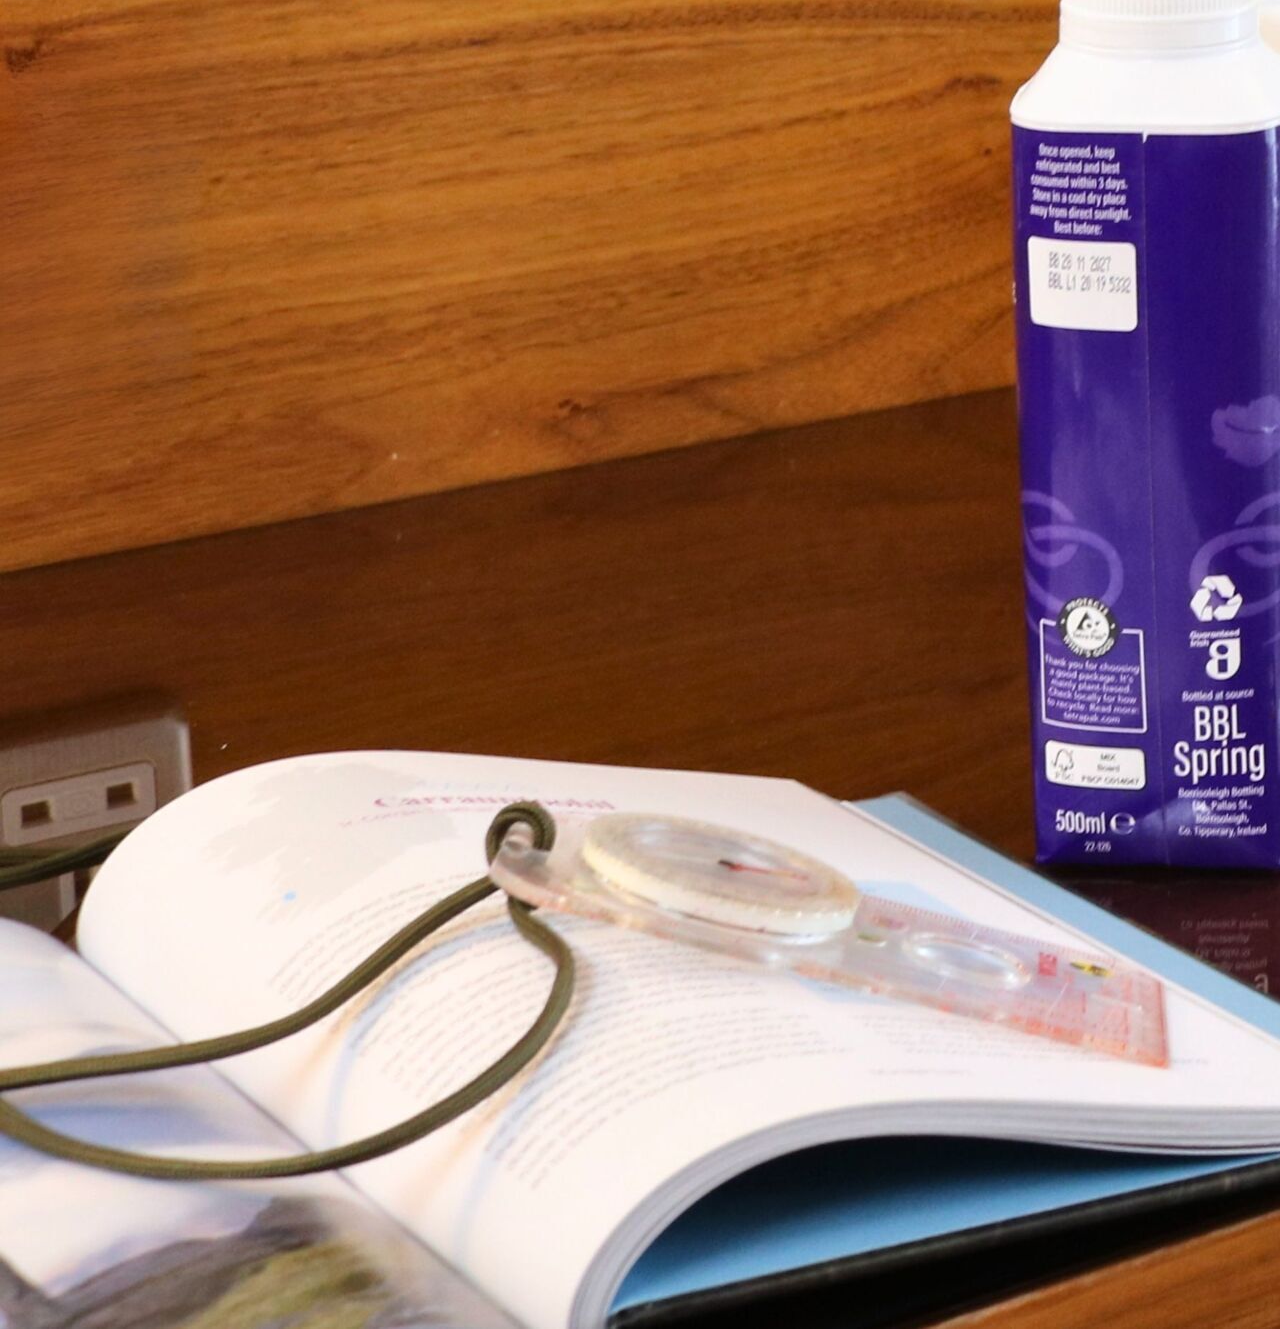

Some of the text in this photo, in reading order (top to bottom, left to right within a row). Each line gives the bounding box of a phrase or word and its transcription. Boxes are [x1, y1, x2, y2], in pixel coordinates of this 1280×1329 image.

[1039, 143, 1059, 158] Once
[1095, 145, 1115, 161] keep
[1036, 158, 1120, 175] refrigerated and best
[1031, 174, 1069, 188] consumed
[1070, 176, 1097, 189] within
[1098, 176, 1104, 190] 3
[1033, 187, 1051, 202] Store
[1052, 189, 1060, 203] in
[1068, 190, 1086, 205] cool
[1087, 191, 1102, 207] dry
[1103, 191, 1126, 207] place
[1030, 204, 1048, 219] away
[1048, 204, 1067, 218] from
[1068, 206, 1093, 220] direct
[1053, 220, 1072, 233] Best
[1045, 653, 1140, 676] Thank you for choosing
[1055, 668, 1078, 681] good
[1050, 678, 1077, 691] mainly
[1047, 686, 1138, 705] Check locally for how
[1182, 688, 1255, 702] Bottled at source
[1047, 697, 1055, 707] to
[1089, 702, 1112, 713] Read
[1063, 712, 1121, 725] tetrapak.com
[1193, 703, 1247, 742] BBL
[1174, 738, 1265, 785] Spring
[1231, 784, 1265, 799] Bottling
[1055, 808, 1107, 835] 500ml
[1237, 822, 1268, 837] Ireland
